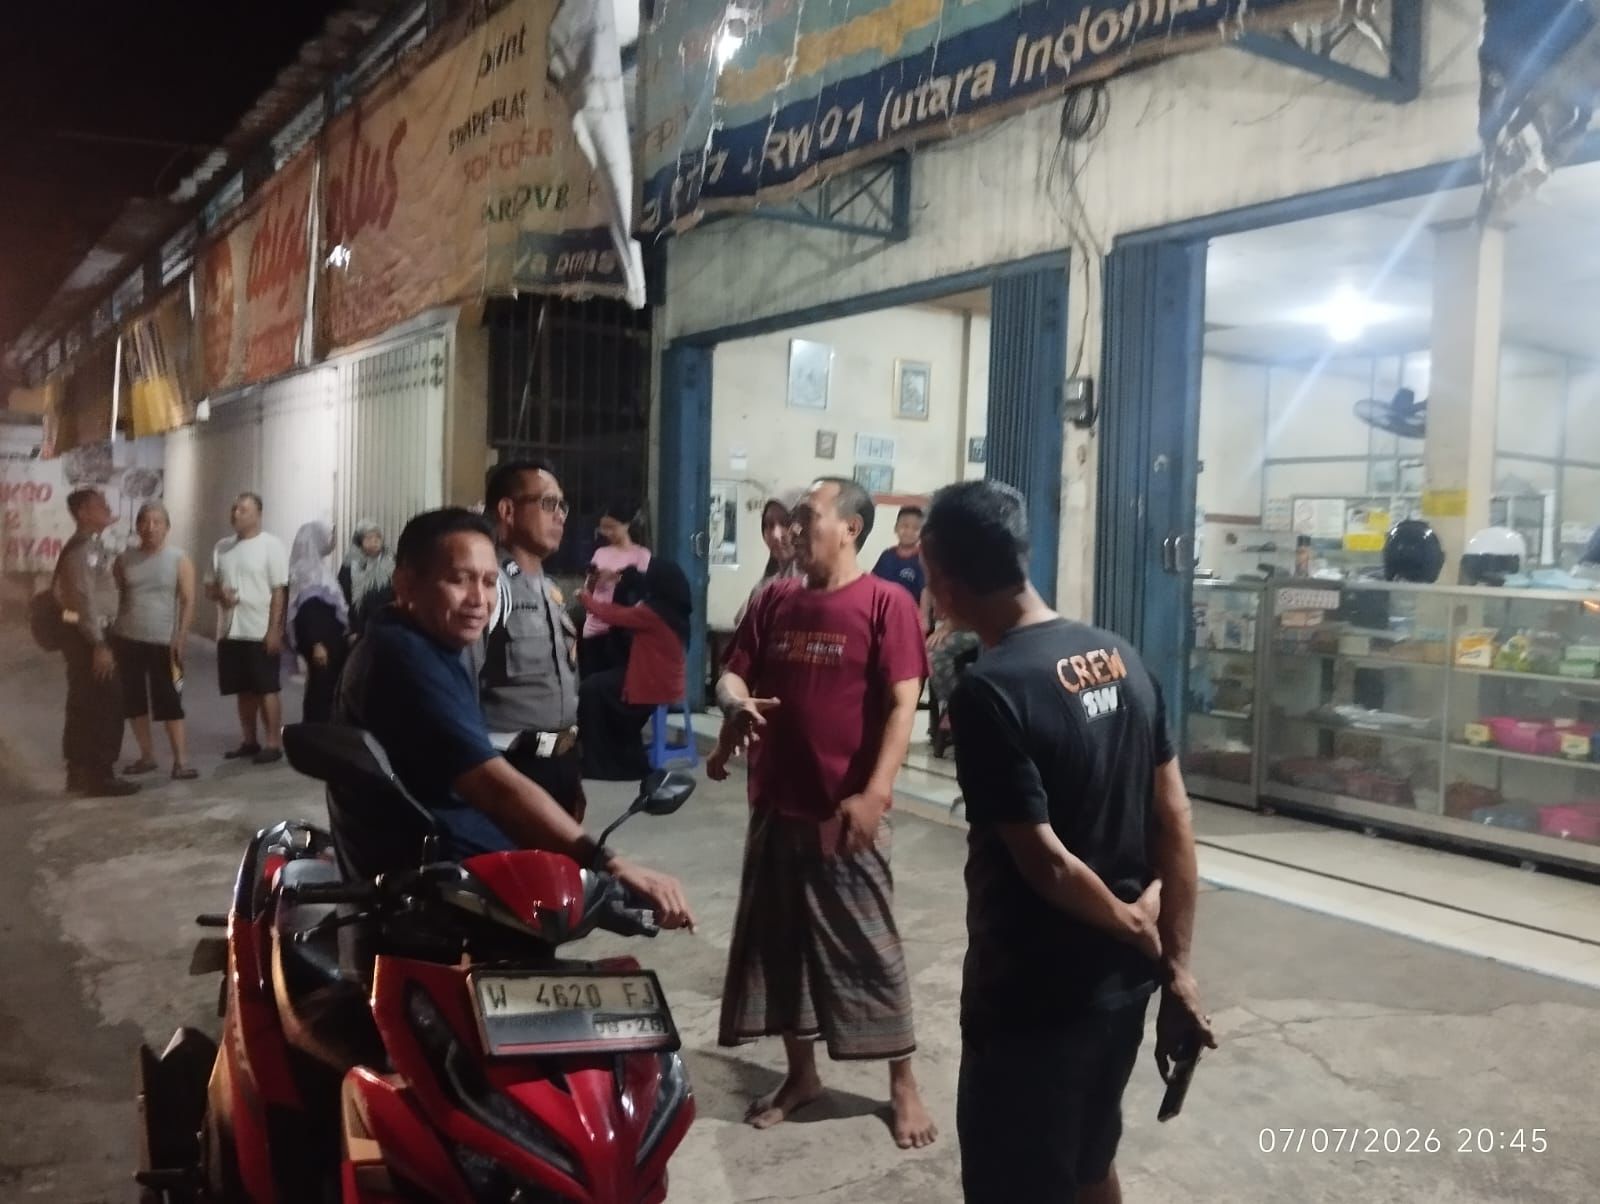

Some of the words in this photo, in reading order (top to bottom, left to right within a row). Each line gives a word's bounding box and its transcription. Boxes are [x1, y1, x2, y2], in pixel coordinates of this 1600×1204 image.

[878, 58, 996, 138] (utara
[1056, 647, 1127, 693] CREW
[1083, 686, 1118, 718] SW
[488, 984, 507, 1009] W
[536, 983, 602, 1008] 4620
[623, 983, 655, 1006] FJ
